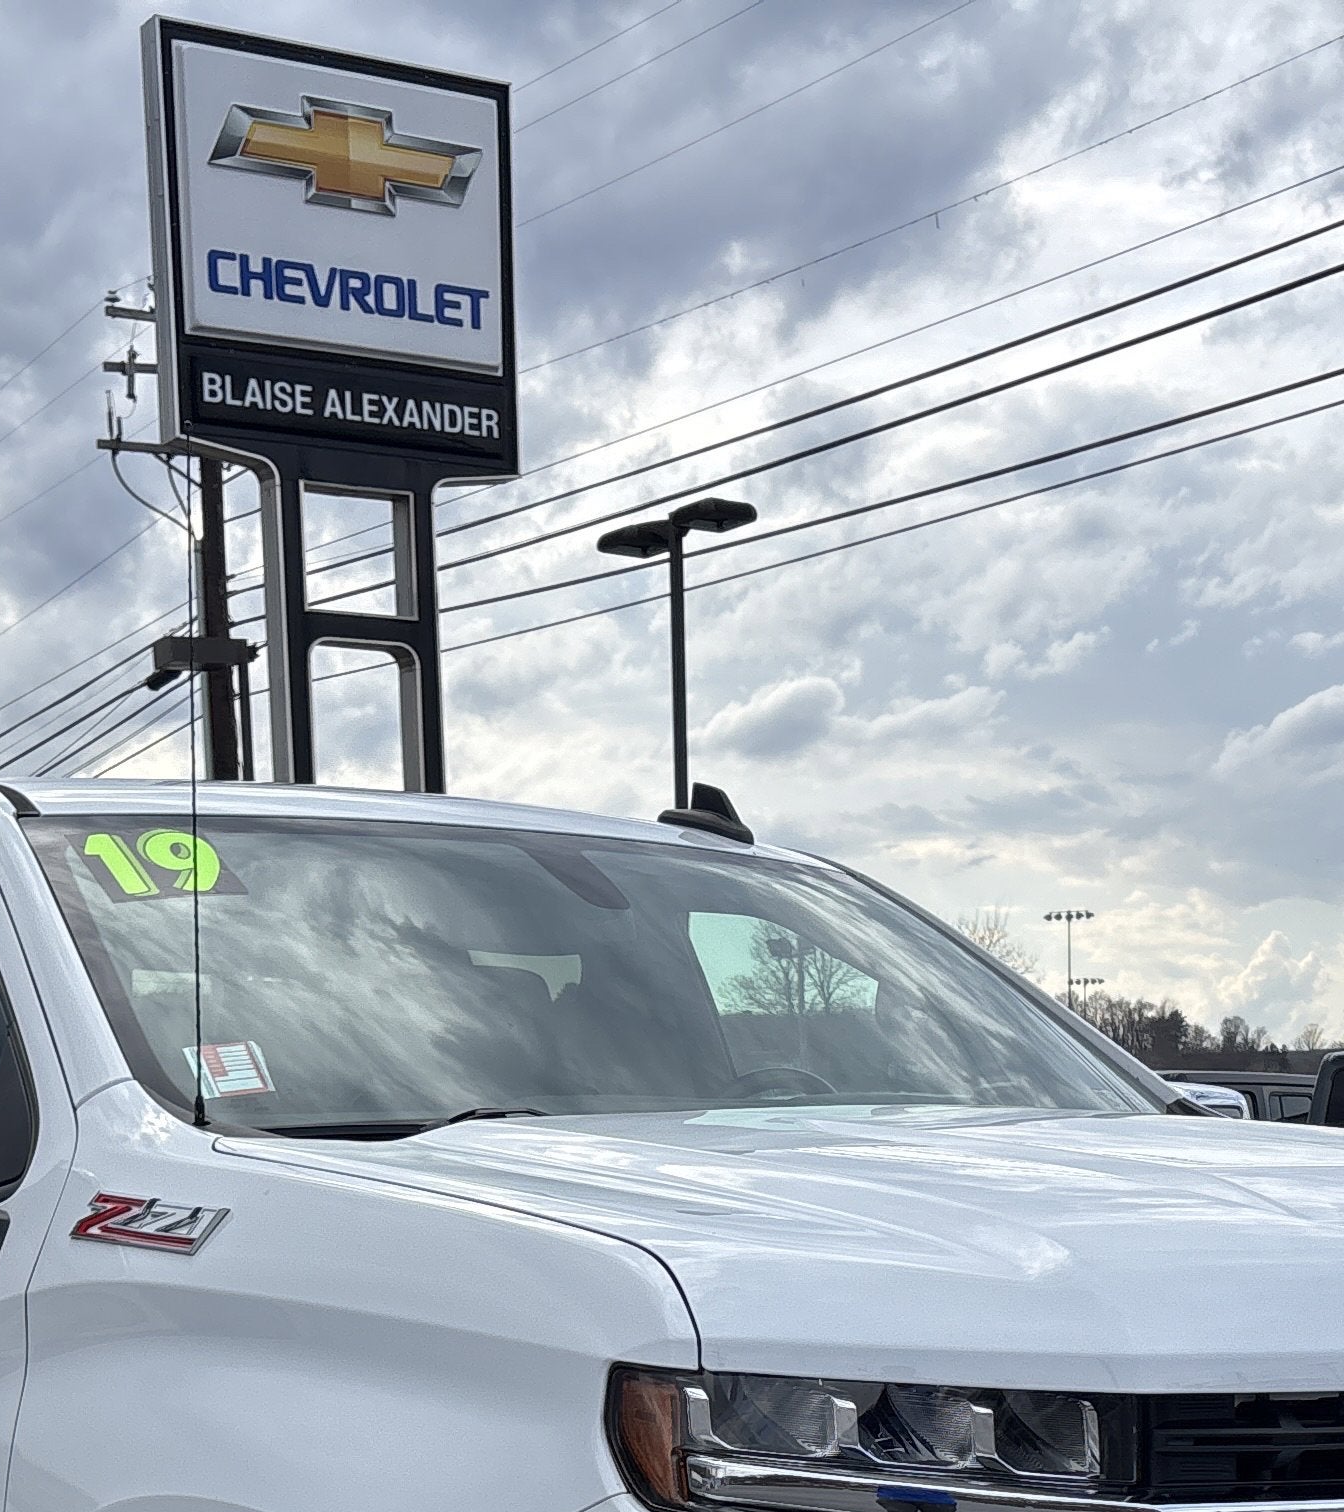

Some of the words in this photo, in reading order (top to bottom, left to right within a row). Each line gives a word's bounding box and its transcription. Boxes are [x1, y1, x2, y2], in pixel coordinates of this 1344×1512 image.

[207, 248, 490, 330] CHEVROLET
[201, 371, 314, 416] BLAISE
[323, 387, 501, 440] ALEXANDER
[83, 829, 222, 896] 19
[69, 1190, 232, 1257] Z71
